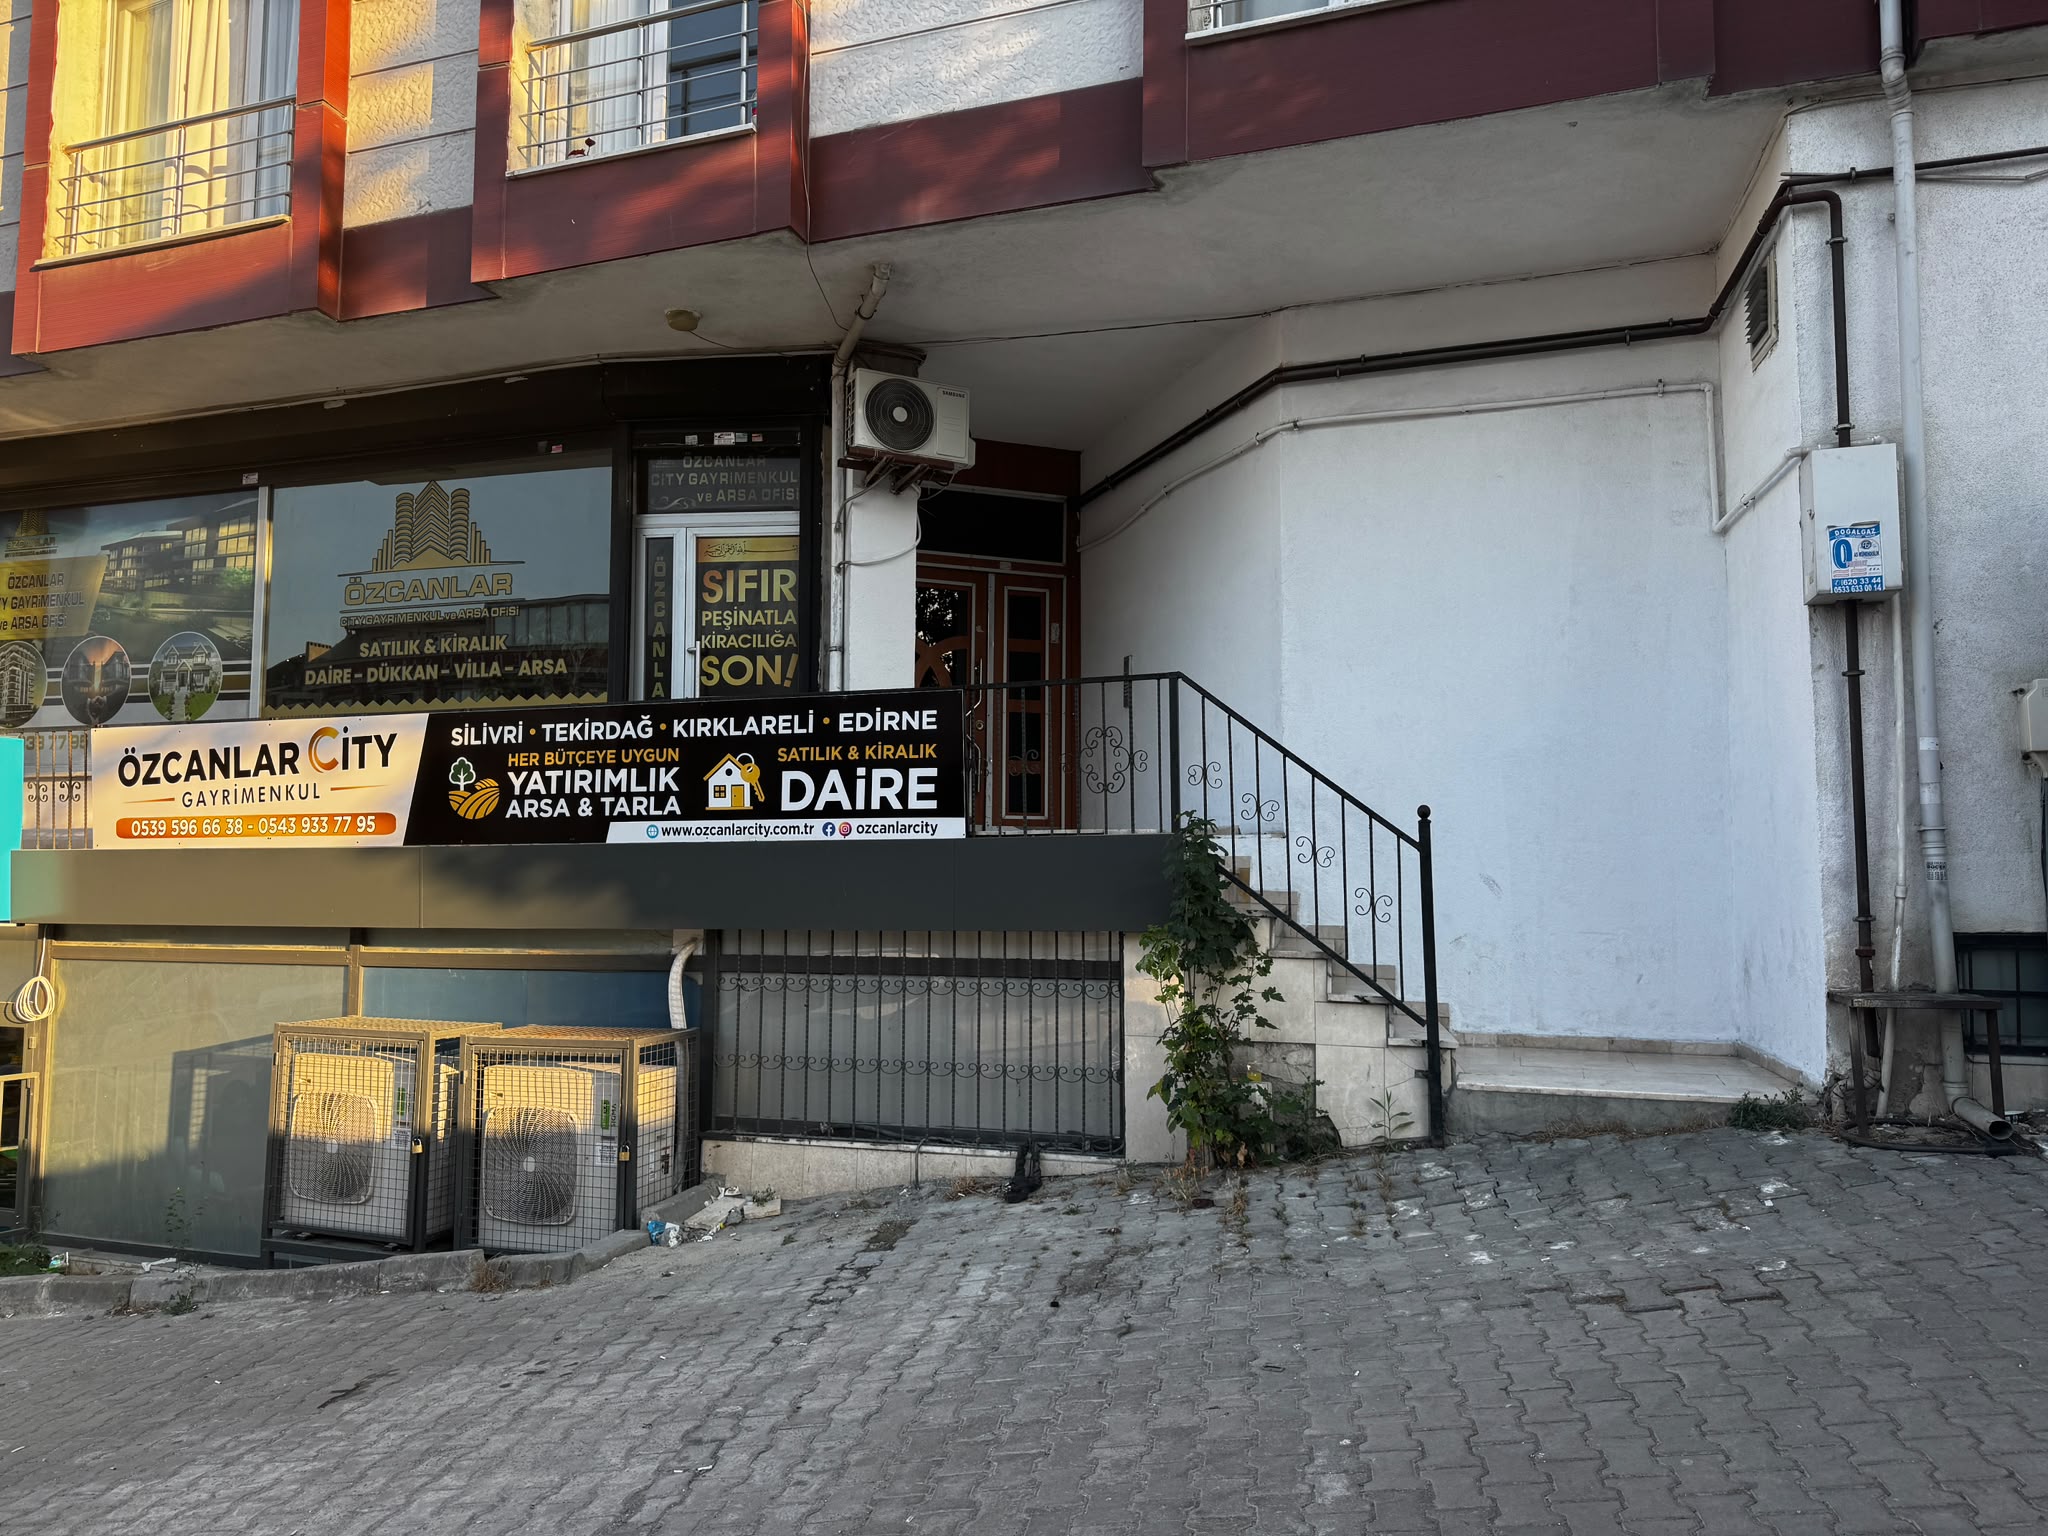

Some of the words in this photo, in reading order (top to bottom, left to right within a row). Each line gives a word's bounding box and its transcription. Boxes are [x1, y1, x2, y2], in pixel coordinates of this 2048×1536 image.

[697, 492, 712, 502] ve
[716, 489, 757, 501] ARSA
[8, 572, 64, 589] ÖZCANLAR
[344, 573, 513, 606] ÖZCANLAR
[702, 569, 797, 603] SIFIR
[11, 615, 38, 631] ARSA
[444, 612, 457, 620] ve
[457, 608, 489, 618] ARSA
[701, 606, 797, 630] PEŞİNATLA
[359, 639, 420, 658] SATILIK
[424, 638, 437, 654] &
[440, 633, 508, 653] KİRALIK
[701, 630, 797, 649] KİRACILIĞA
[304, 665, 352, 686] DAİRE
[366, 663, 439, 683] DÜKKAN
[454, 658, 502, 679] VİLLA
[518, 658, 568, 677] ARSA
[700, 653, 799, 688] SON!
[450, 720, 523, 747] SİLİVRİ
[541, 714, 653, 742] TEKİRDAĞ
[672, 709, 814, 739] KIRKLARELİ
[838, 707, 938, 733] EDİRNE
[507, 752, 539, 767] HER
[544, 748, 617, 767] BÜTÇEYE
[621, 747, 679, 763] UYGUN
[777, 745, 842, 762] SATILIK
[847, 746, 860, 761] &
[865, 741, 938, 760] KİRALIK
[118, 741, 300, 787] ÖZCANLAR
[507, 766, 680, 796] YATIRIMLIK
[182, 782, 320, 808] GAYRİMENKUL
[505, 798, 571, 819] ARSA
[577, 797, 593, 817] &
[601, 795, 682, 817] TARLA
[131, 819, 166, 837] 0539
[171, 818, 198, 836] 596
[202, 818, 221, 836] 66
[225, 817, 243, 835] 38
[258, 816, 297, 835] 0543
[301, 815, 328, 834] 933
[333, 815, 352, 833] 77
[356, 815, 376, 833] 95
[661, 822, 815, 839] www.ozcanlarcity.com.tr
[856, 820, 938, 837] ozcanlarcity
